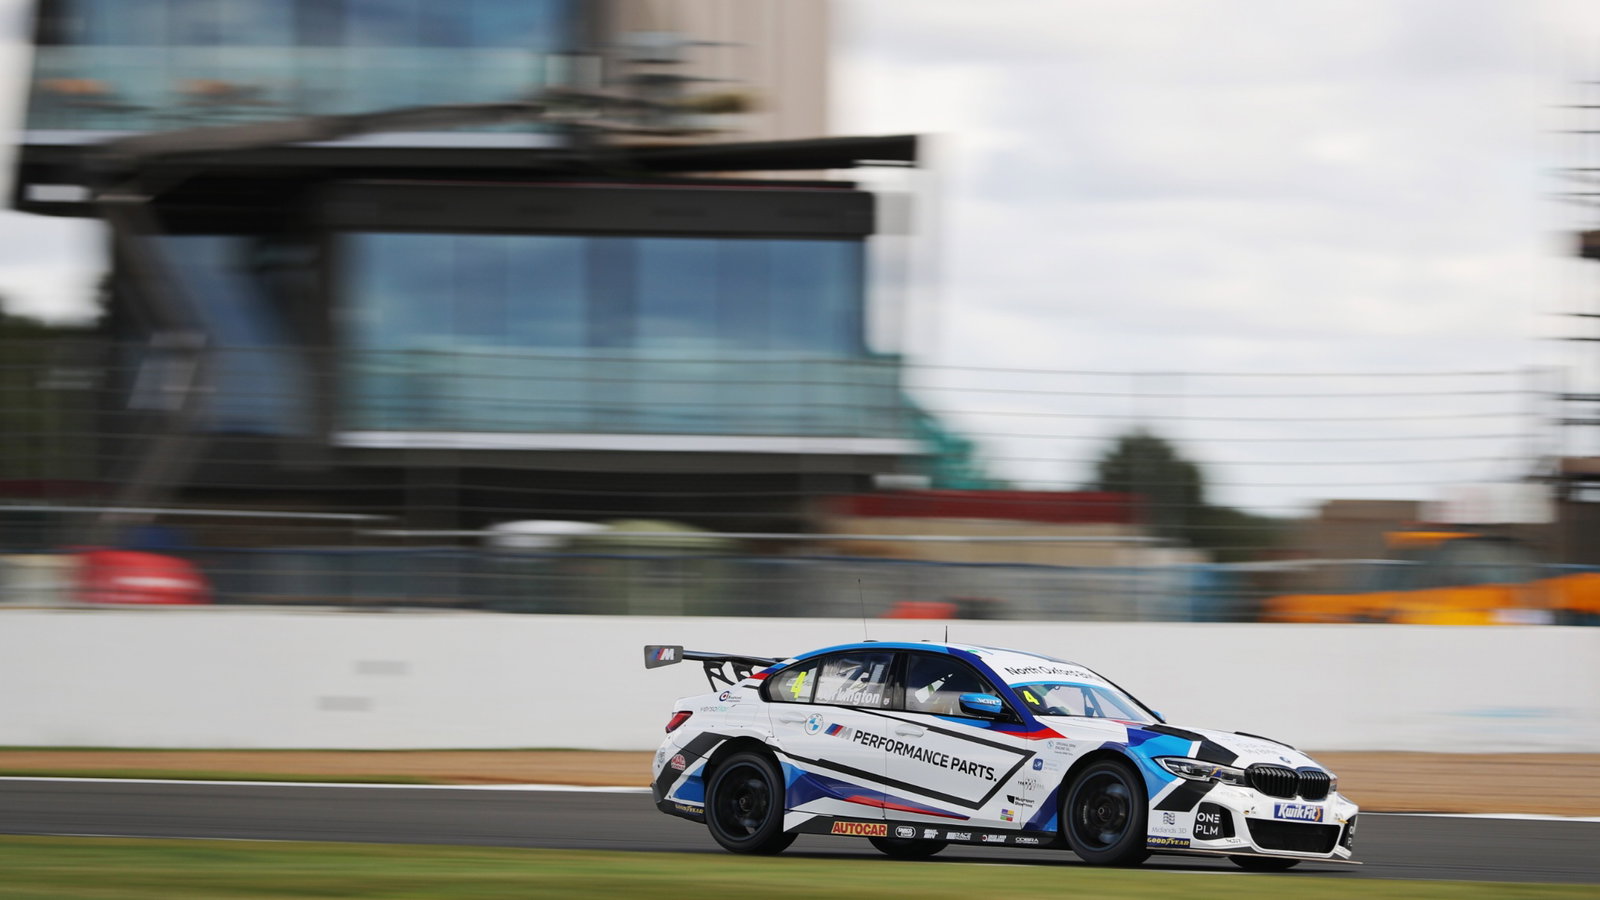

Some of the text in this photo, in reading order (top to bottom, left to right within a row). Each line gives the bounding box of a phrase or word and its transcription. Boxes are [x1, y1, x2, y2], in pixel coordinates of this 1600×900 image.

[1004, 666, 1038, 675] North
[790, 671, 807, 699] 4
[1023, 690, 1040, 706] 4
[853, 730, 949, 768] PERFORMANCE
[950, 757, 997, 782] PARTS.
[674, 804, 704, 814] GOODYEAR
[1197, 812, 1220, 823] ONE
[832, 822, 887, 836] AUTOCAR
[1195, 824, 1219, 835] PLM
[1147, 837, 1190, 846] GOODYEAR
